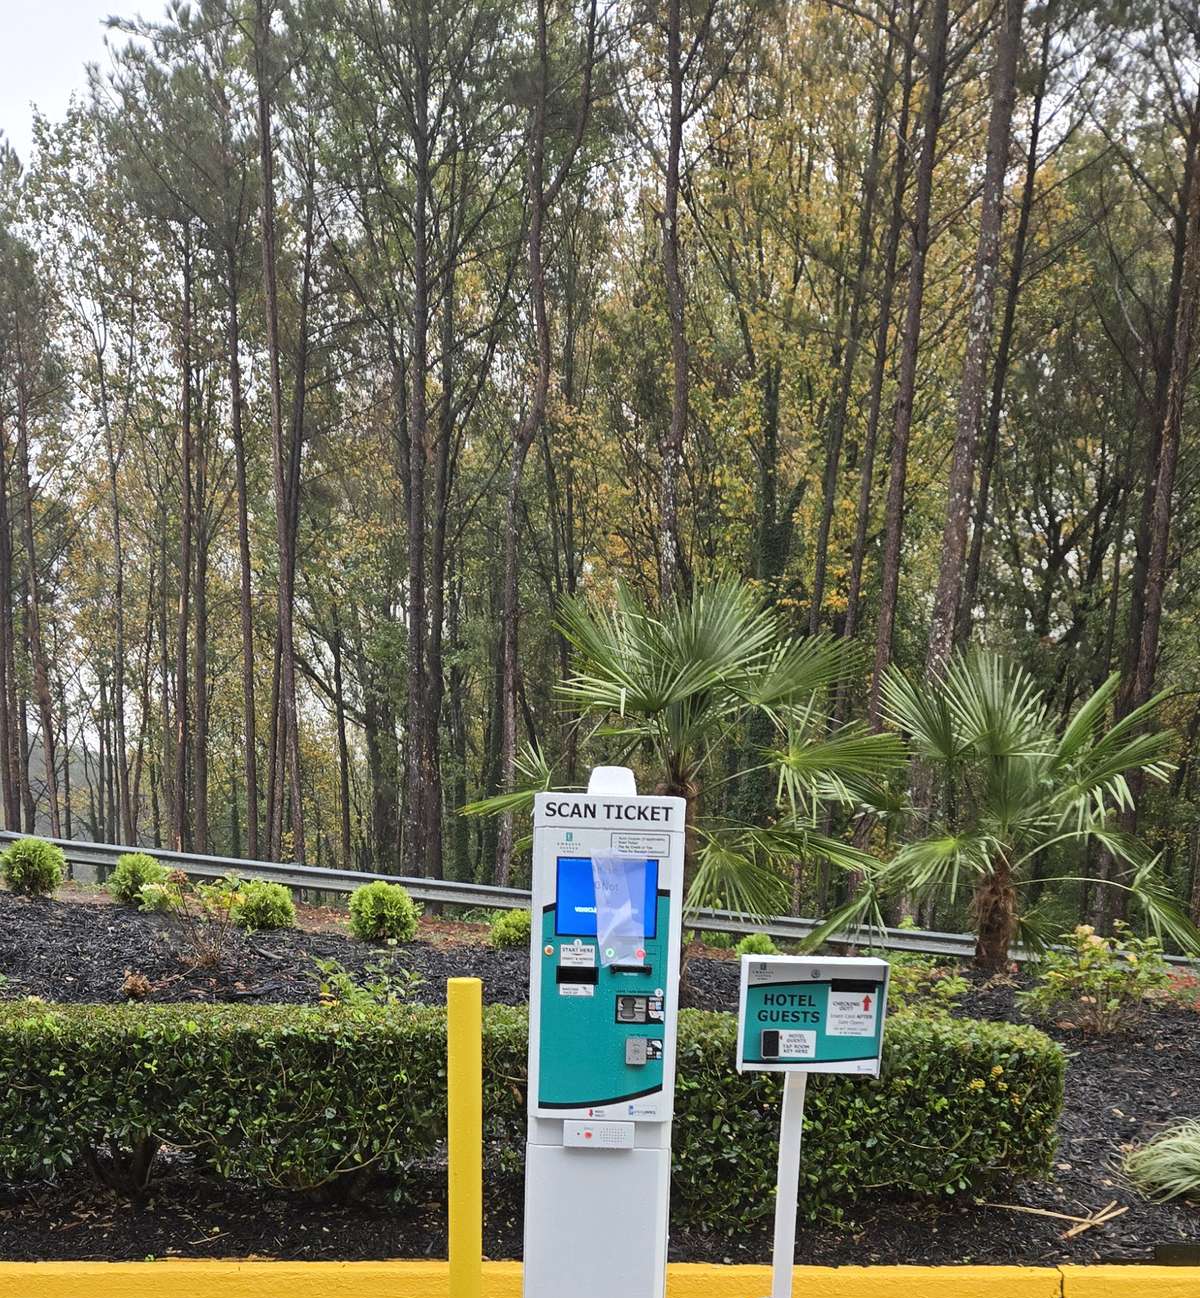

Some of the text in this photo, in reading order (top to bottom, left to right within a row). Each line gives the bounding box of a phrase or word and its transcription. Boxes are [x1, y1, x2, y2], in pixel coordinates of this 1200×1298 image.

[545, 802, 673, 822] SCAN TICKET
[764, 994, 817, 1007] HOTEL
[758, 1010, 820, 1023] GUESTS
